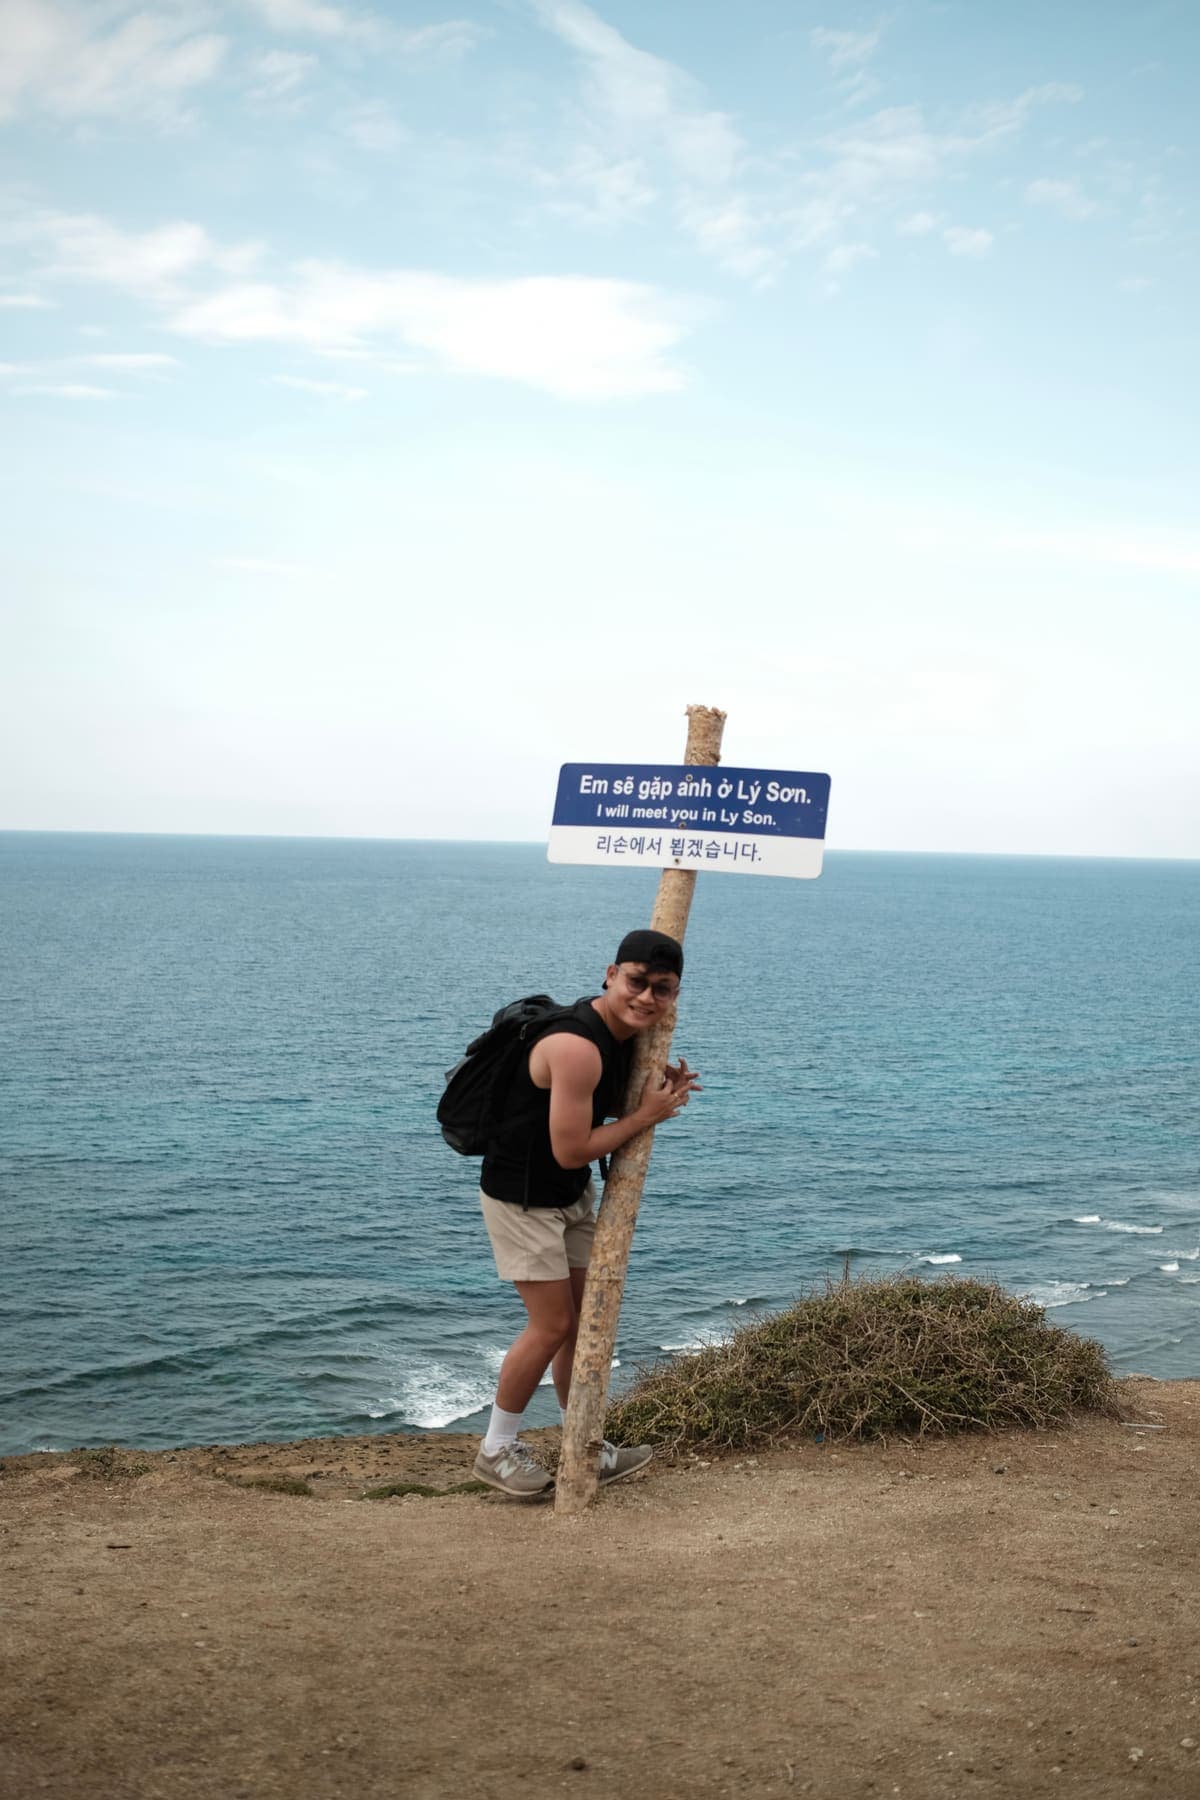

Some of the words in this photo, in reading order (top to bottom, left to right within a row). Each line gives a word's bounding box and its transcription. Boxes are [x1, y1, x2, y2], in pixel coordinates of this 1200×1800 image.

[580, 775, 608, 794] Em
[613, 776, 634, 795] sẽ
[638, 776, 672, 799] gặp
[677, 779, 711, 798] anh
[717, 781, 733, 799] ở
[737, 780, 761, 805] Lý
[766, 782, 812, 804] Sơn.
[597, 804, 602, 817] I
[605, 806, 629, 818] will
[632, 807, 667, 820] meet
[670, 810, 698, 823] you
[702, 810, 716, 822] in
[720, 811, 738, 826] Ly
[742, 810, 777, 826] Son.
[596, 835, 662, 856] 리손에서
[669, 837, 763, 862] 뵙겠습니다.
